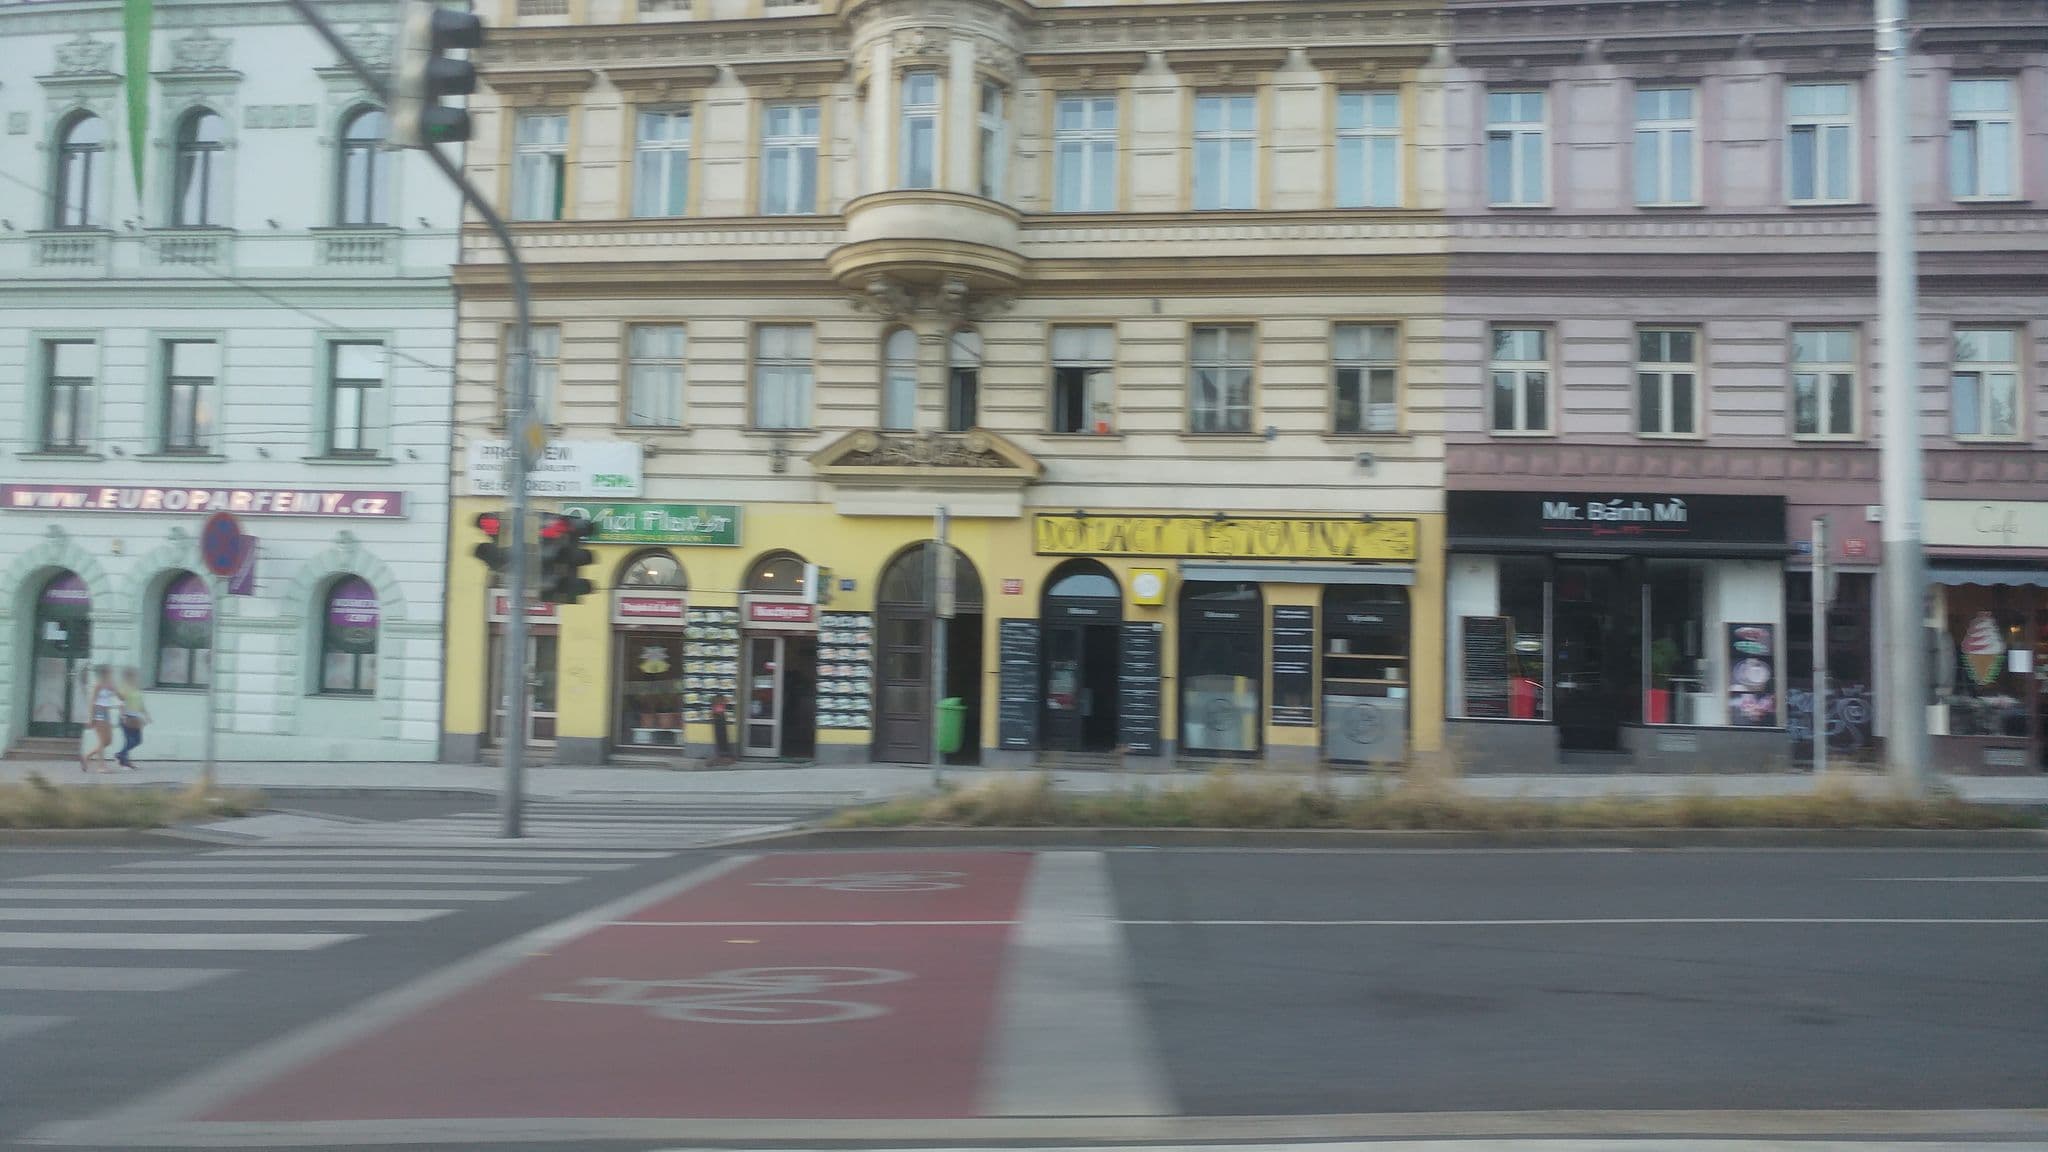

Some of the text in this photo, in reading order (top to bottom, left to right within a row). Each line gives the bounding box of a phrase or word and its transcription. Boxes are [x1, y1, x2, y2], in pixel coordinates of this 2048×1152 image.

[12, 487, 388, 515] www.EUROPARFEMY.cz
[1542, 498, 1688, 522] Mr. Bánh Mì
